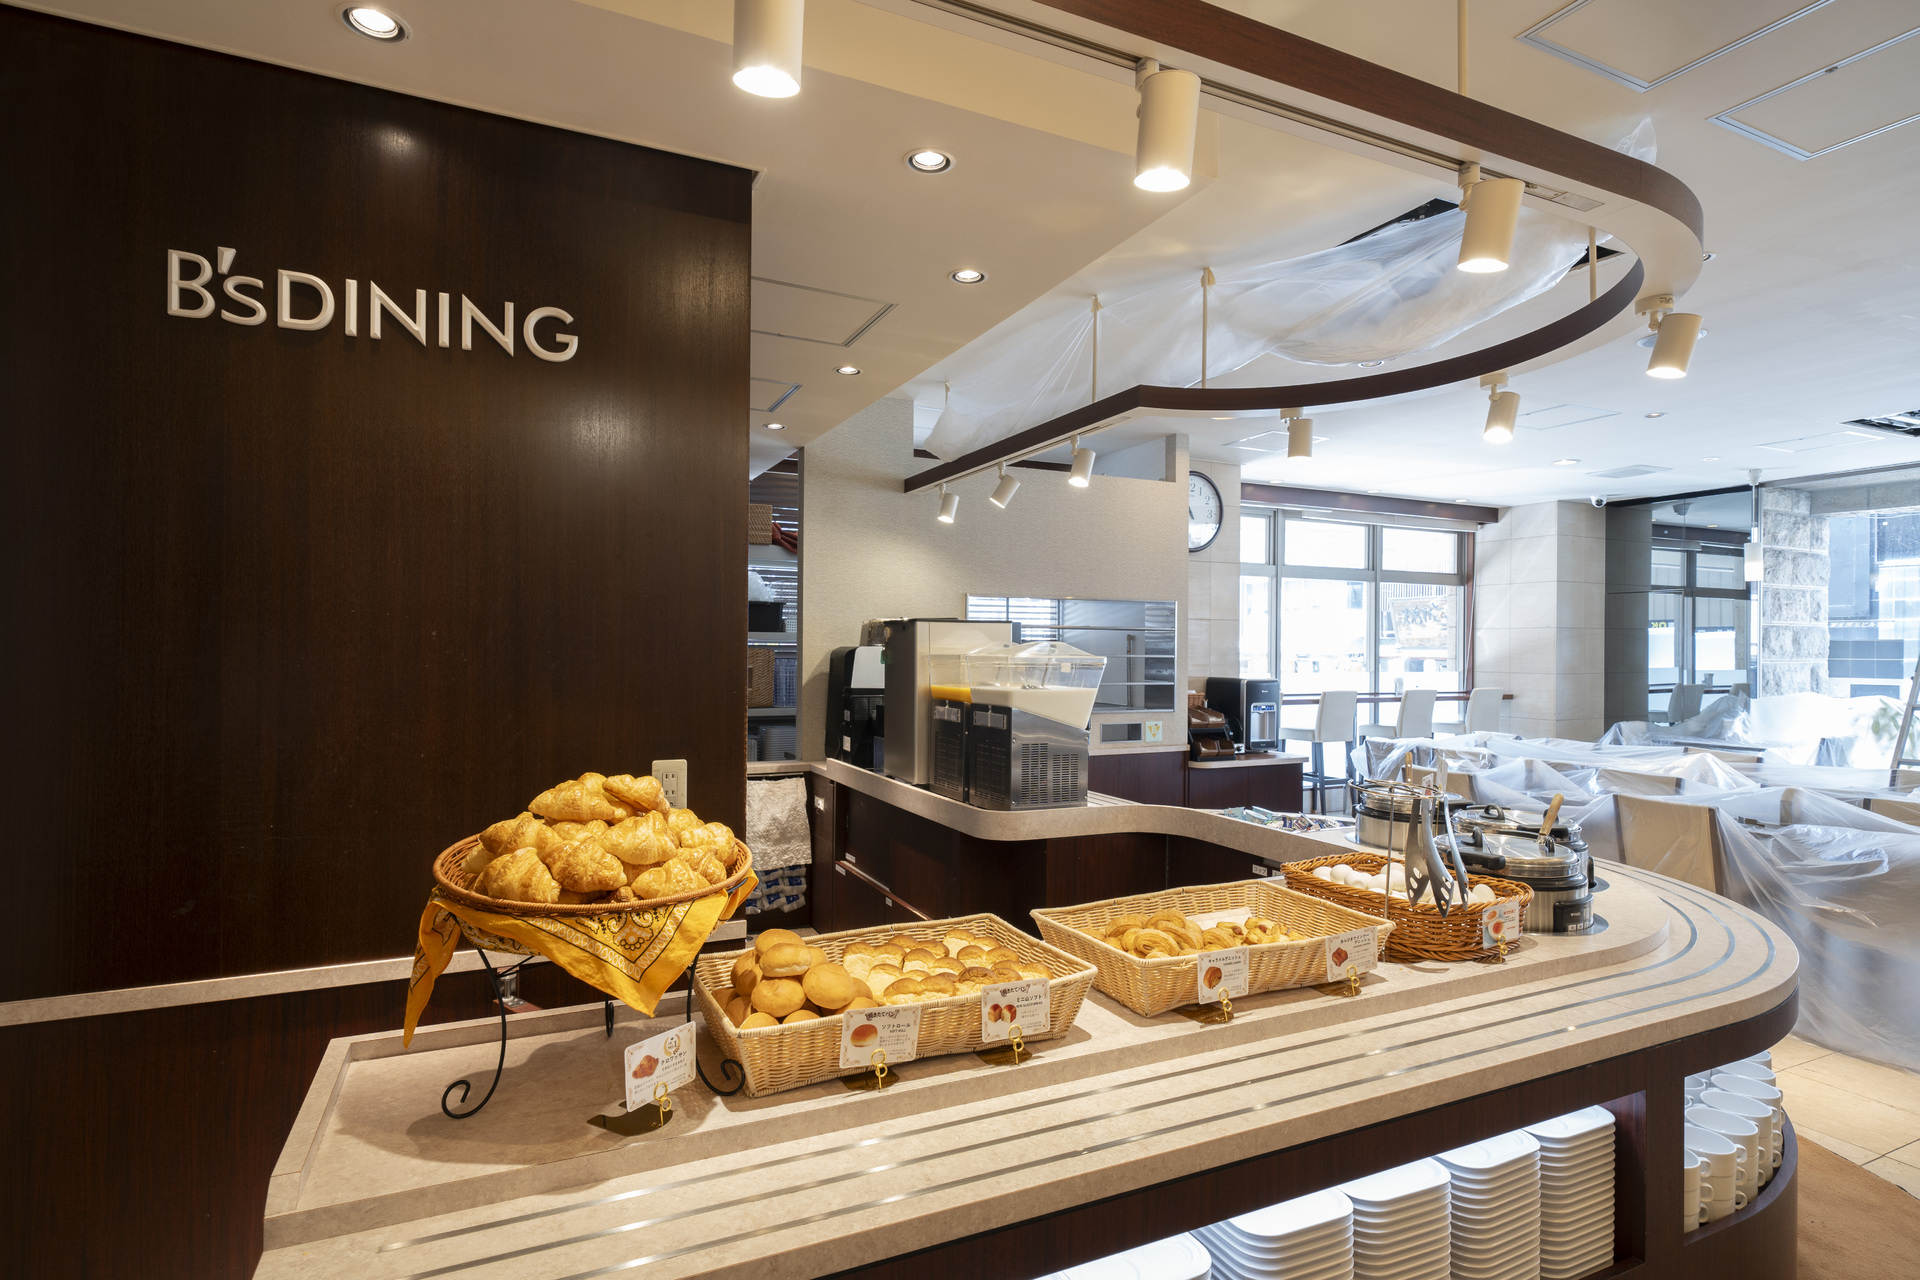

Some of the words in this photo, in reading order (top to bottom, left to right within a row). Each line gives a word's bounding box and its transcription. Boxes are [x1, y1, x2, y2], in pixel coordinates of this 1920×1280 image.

[1204, 495, 1211, 505] 2
[1206, 509, 1213, 519] 3
[1016, 994, 1042, 1003] ミニ山ソフト
[881, 1022, 911, 1030] ソフトロール
[660, 1051, 688, 1066] クロワッサン
